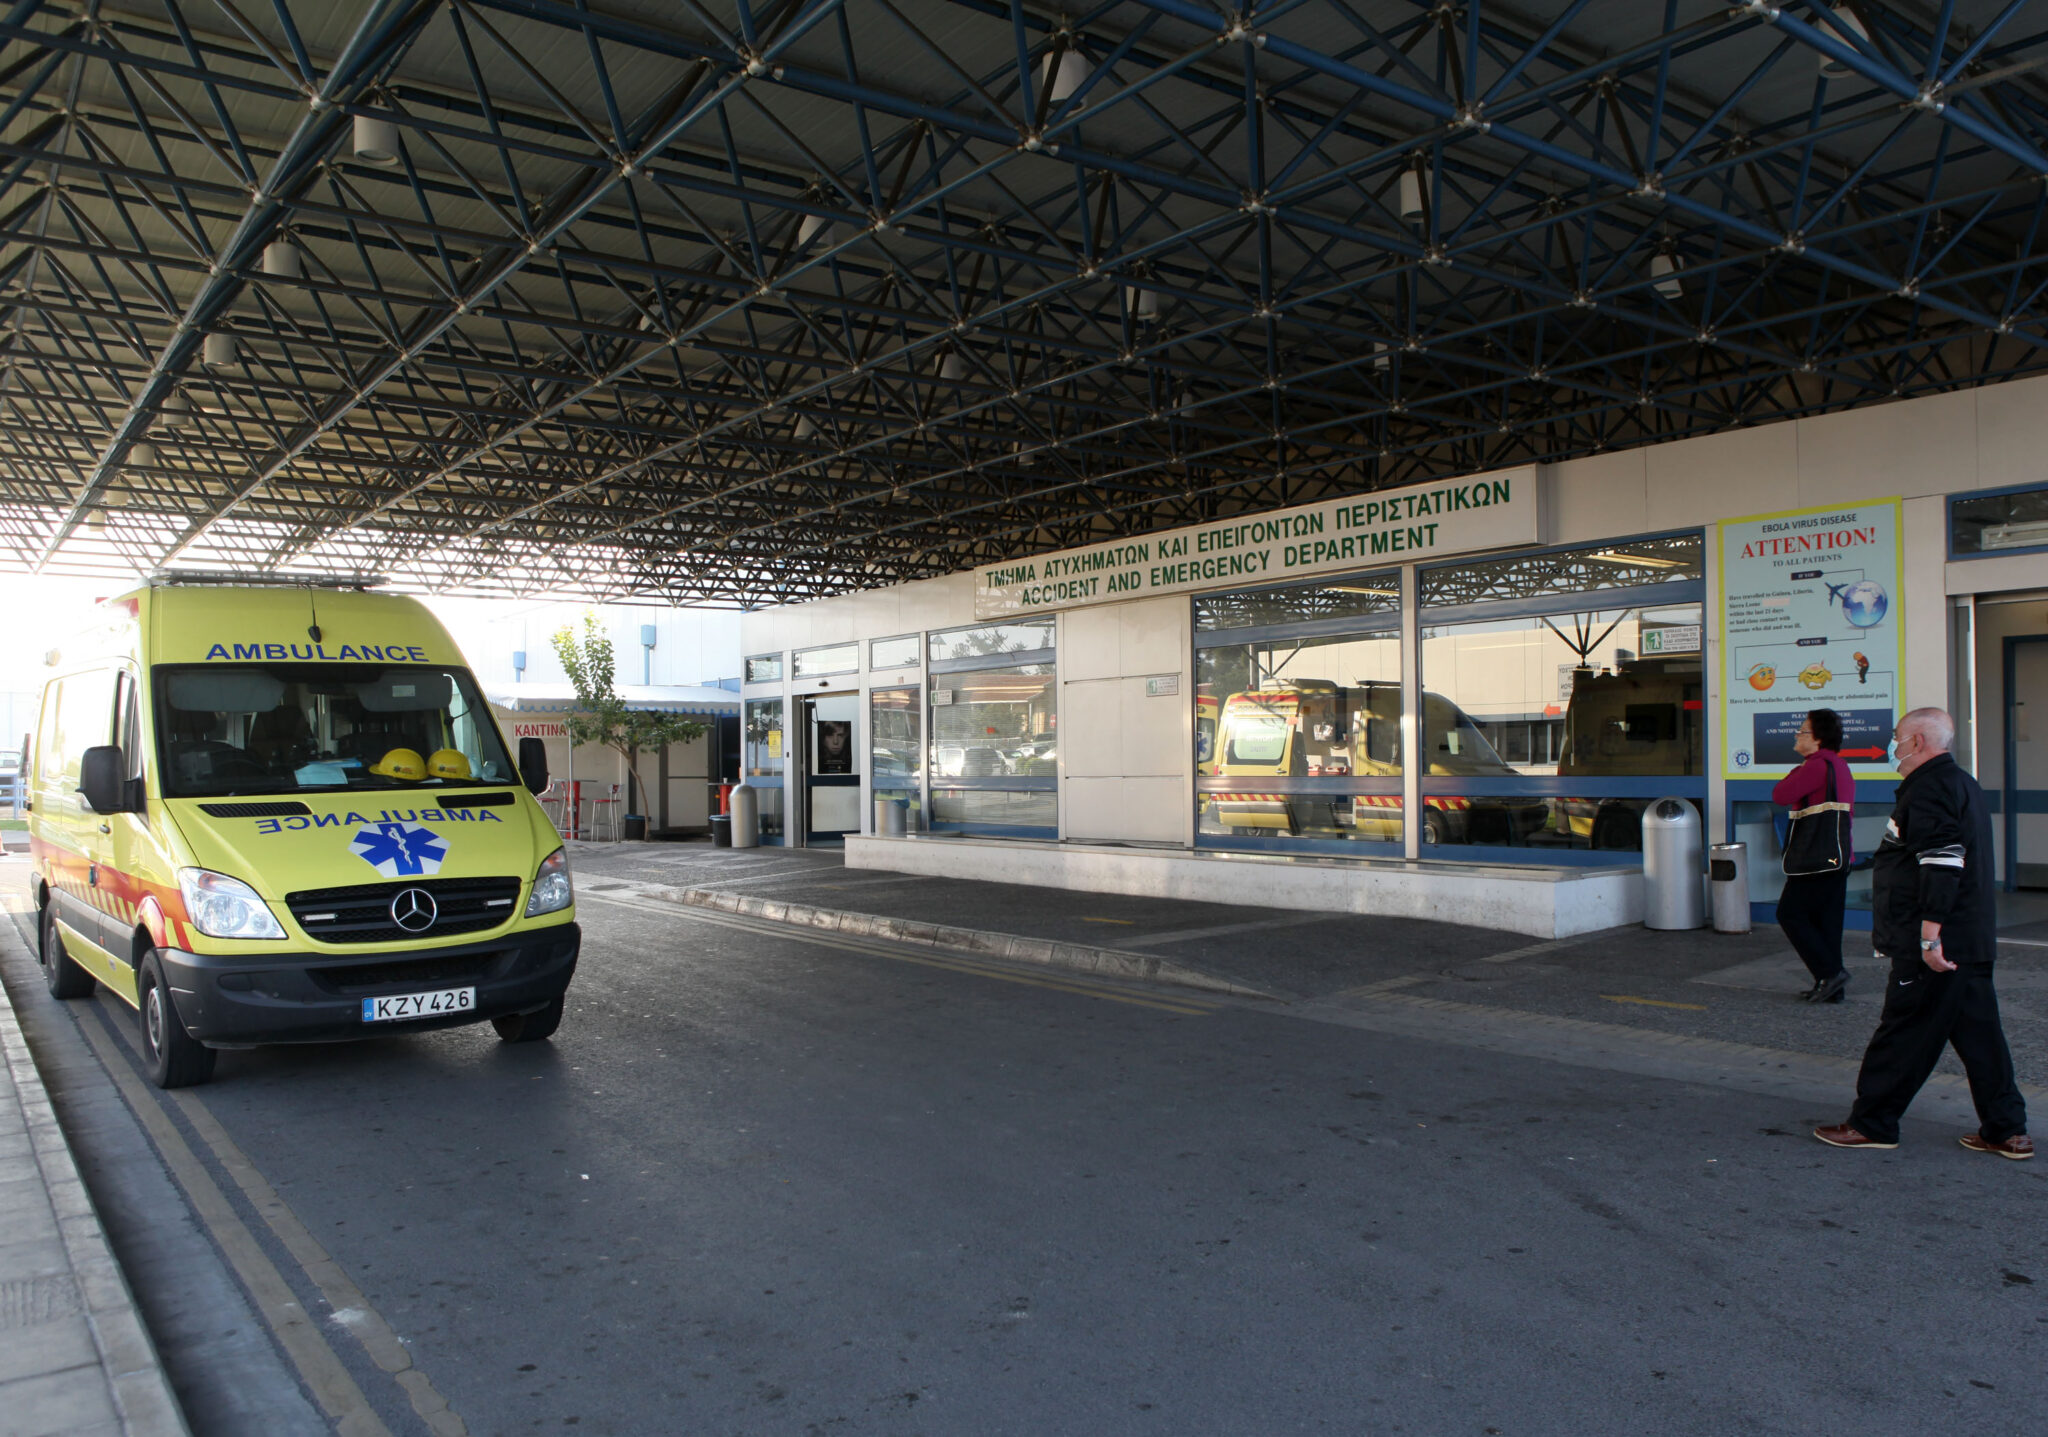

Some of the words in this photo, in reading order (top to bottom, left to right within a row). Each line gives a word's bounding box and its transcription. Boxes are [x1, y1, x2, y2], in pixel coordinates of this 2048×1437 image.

[1762, 522, 1790, 533] EBOLA
[1791, 518, 1818, 530] VIRUS
[1820, 513, 1857, 526] DISEASE
[986, 565, 1036, 588] ΤΜΗΜΑ
[1044, 544, 1149, 579] ΑΤΥΧΗΜΑΤΩΝ
[1158, 536, 1188, 559] ΚΑΙ
[1198, 512, 1323, 553] ΕΠΕΙΓΟΝΤΩΝ
[1336, 479, 1511, 530] ΠΕΡΙΣΤΑΤΙΚΩΝ
[1741, 527, 1876, 559] ATTENTION!
[1022, 577, 1099, 605] ACCIDENT
[1107, 570, 1142, 593] AND
[1151, 550, 1270, 587] EMERGENCY
[1285, 523, 1439, 567] DEPARTMENT
[1772, 560, 1784, 568] TO
[1784, 558, 1801, 566] ALL
[1802, 553, 1842, 565] PATIENTS
[205, 643, 430, 662] AMBULANCE
[515, 723, 567, 736] KANTINA
